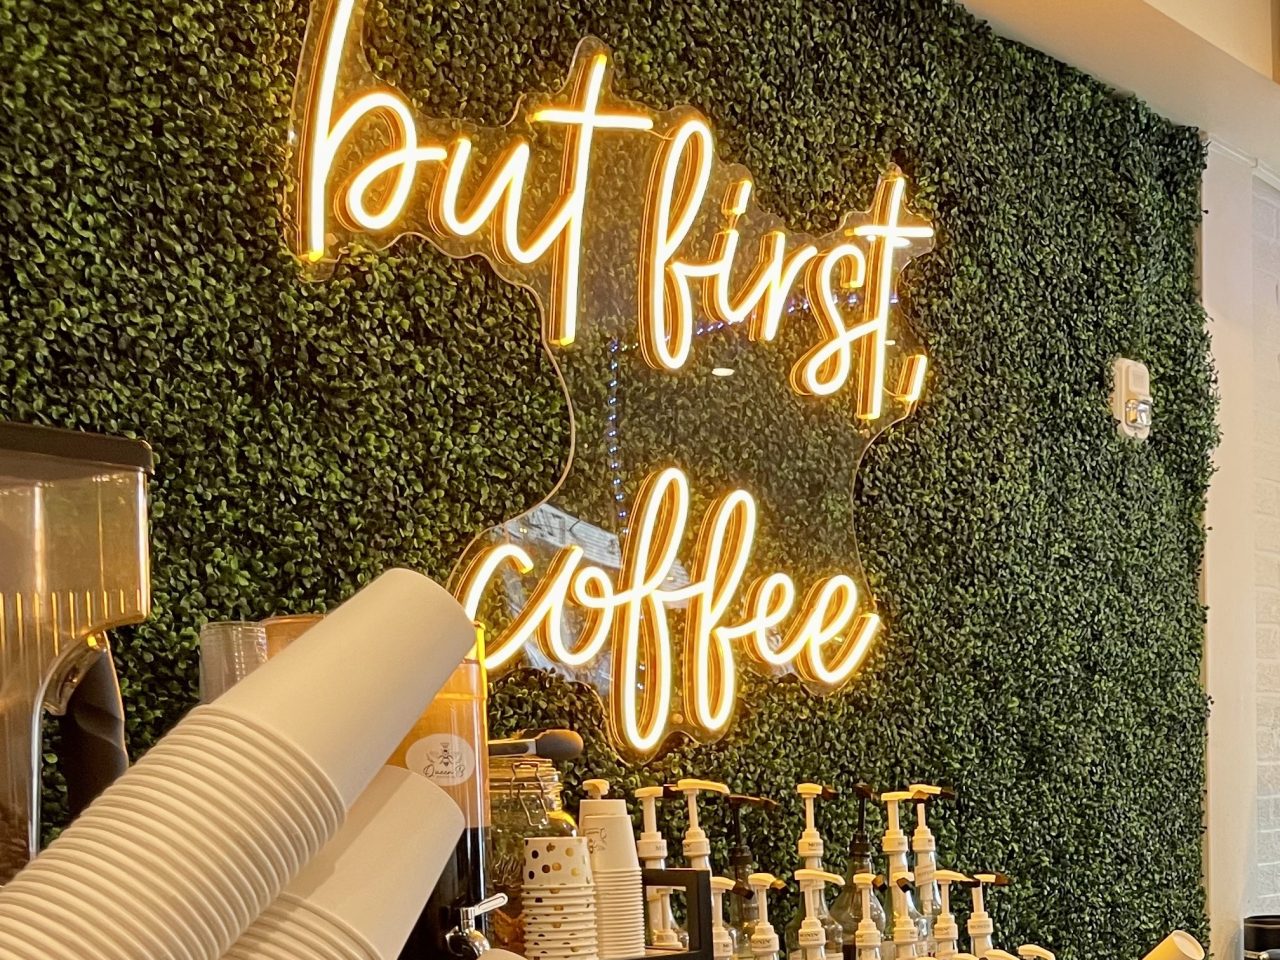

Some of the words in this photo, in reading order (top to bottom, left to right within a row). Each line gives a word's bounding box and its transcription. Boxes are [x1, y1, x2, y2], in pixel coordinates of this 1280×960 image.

[300, 0, 653, 347] but
[640, 118, 935, 420] first,
[456, 467, 881, 753] coffee
